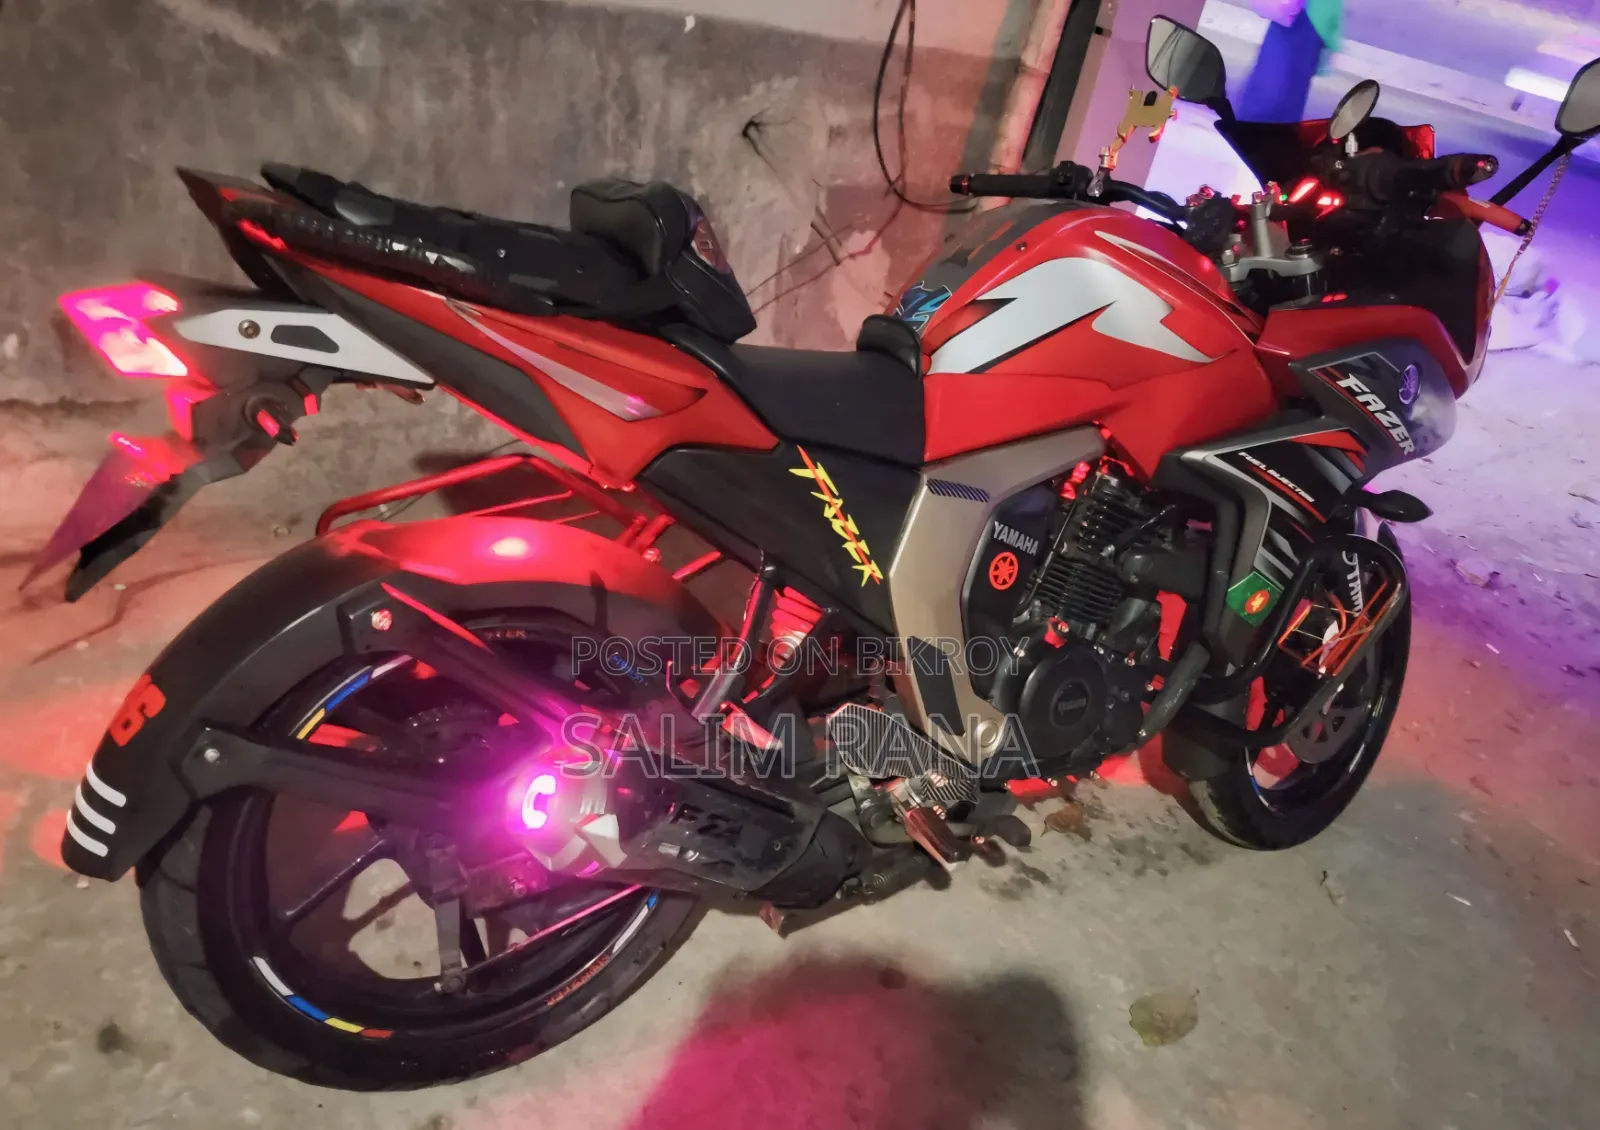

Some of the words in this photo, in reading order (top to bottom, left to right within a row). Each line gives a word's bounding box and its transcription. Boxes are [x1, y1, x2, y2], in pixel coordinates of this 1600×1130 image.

[1336, 373, 1416, 456] FAZER
[1238, 452, 1267, 471] FUEL
[994, 520, 1040, 557] YAMAHA
